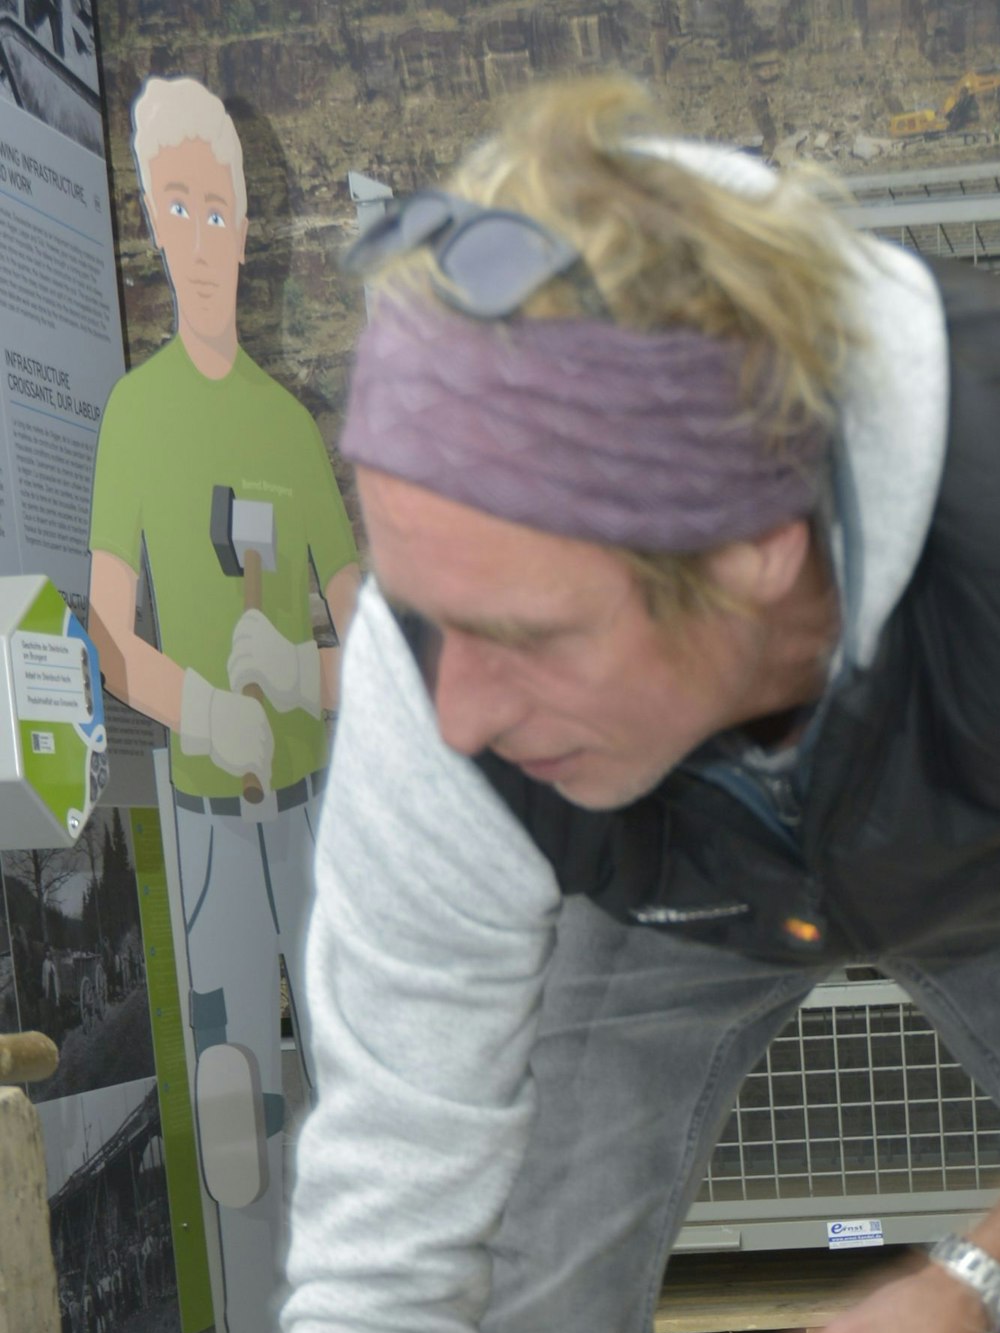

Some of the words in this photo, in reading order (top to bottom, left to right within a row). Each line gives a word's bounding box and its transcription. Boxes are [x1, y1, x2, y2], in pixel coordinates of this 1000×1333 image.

[8, 167, 33, 197] WORK
[21, 153, 86, 207] INFRASTRUCTURE,
[4, 348, 71, 391] INFRASTRUCTURE
[7, 372, 57, 410] CROISSANTE,
[57, 391, 73, 413] DUR
[831, 1223, 863, 1234] ernst
